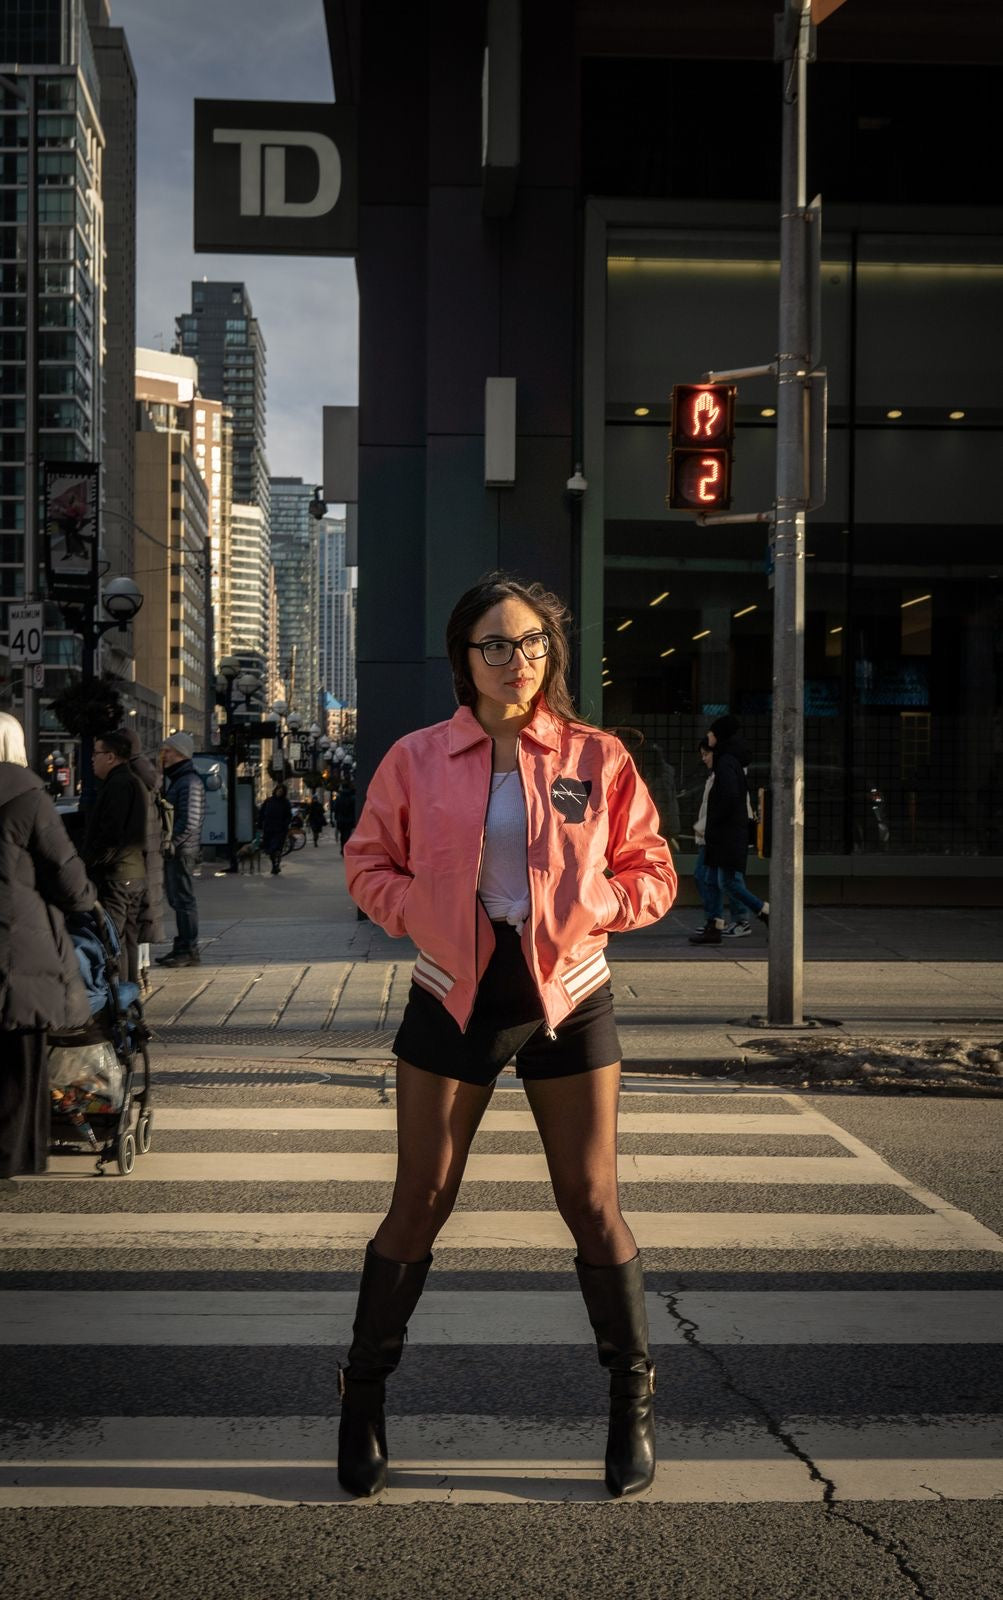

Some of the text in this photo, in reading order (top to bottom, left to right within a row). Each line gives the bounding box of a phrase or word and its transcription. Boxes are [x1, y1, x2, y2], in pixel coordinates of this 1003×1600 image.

[213, 128, 342, 218] TD
[700, 460, 718, 500] 2
[11, 609, 41, 619] MAXIMUM
[11, 628, 41, 656] 40
